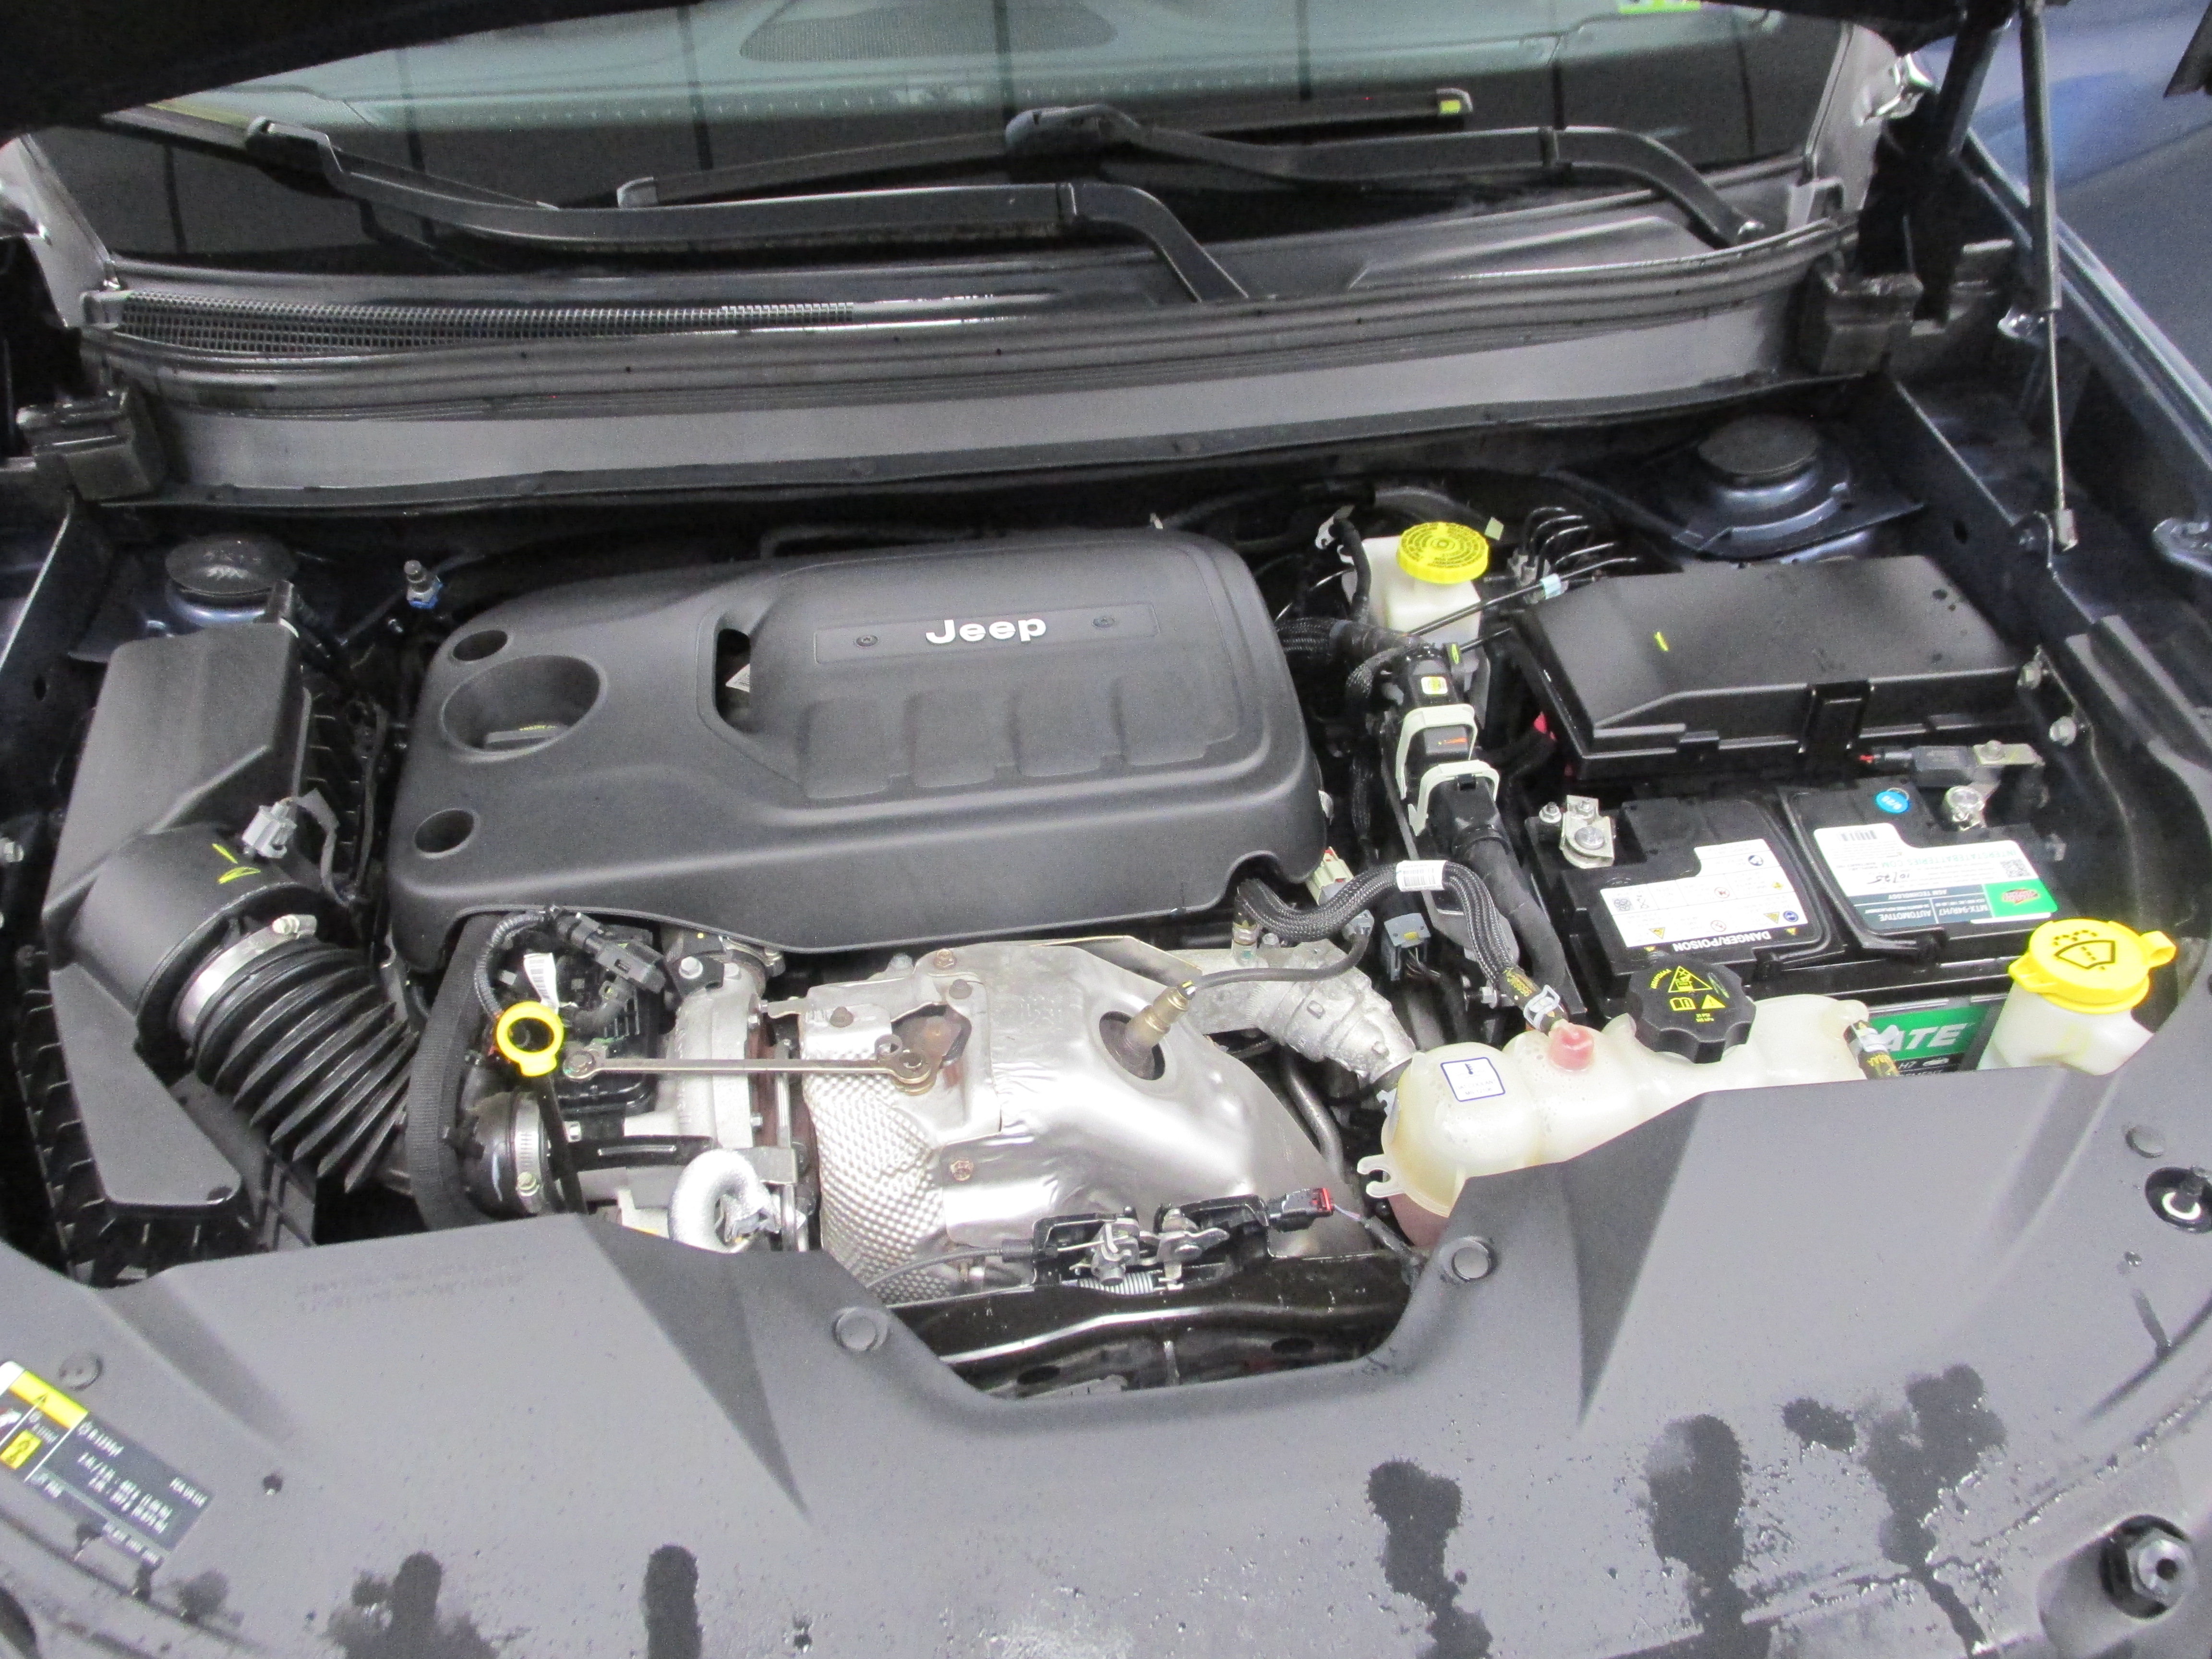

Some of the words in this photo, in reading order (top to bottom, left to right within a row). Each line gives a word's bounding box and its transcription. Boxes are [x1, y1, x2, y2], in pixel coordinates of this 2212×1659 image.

[925, 618, 1046, 645] Jeep
[1881, 849, 2017, 868] INTERSTATEBATTERIESCOM
[1866, 872, 1910, 884] 10/25
[1888, 891, 1930, 900] TECHNOLOGY
[1879, 909, 1932, 922] AUTOMOTIVE
[1938, 904, 1988, 916] MTX-94R/H7
[1672, 930, 1771, 951] DANGER/POISON
